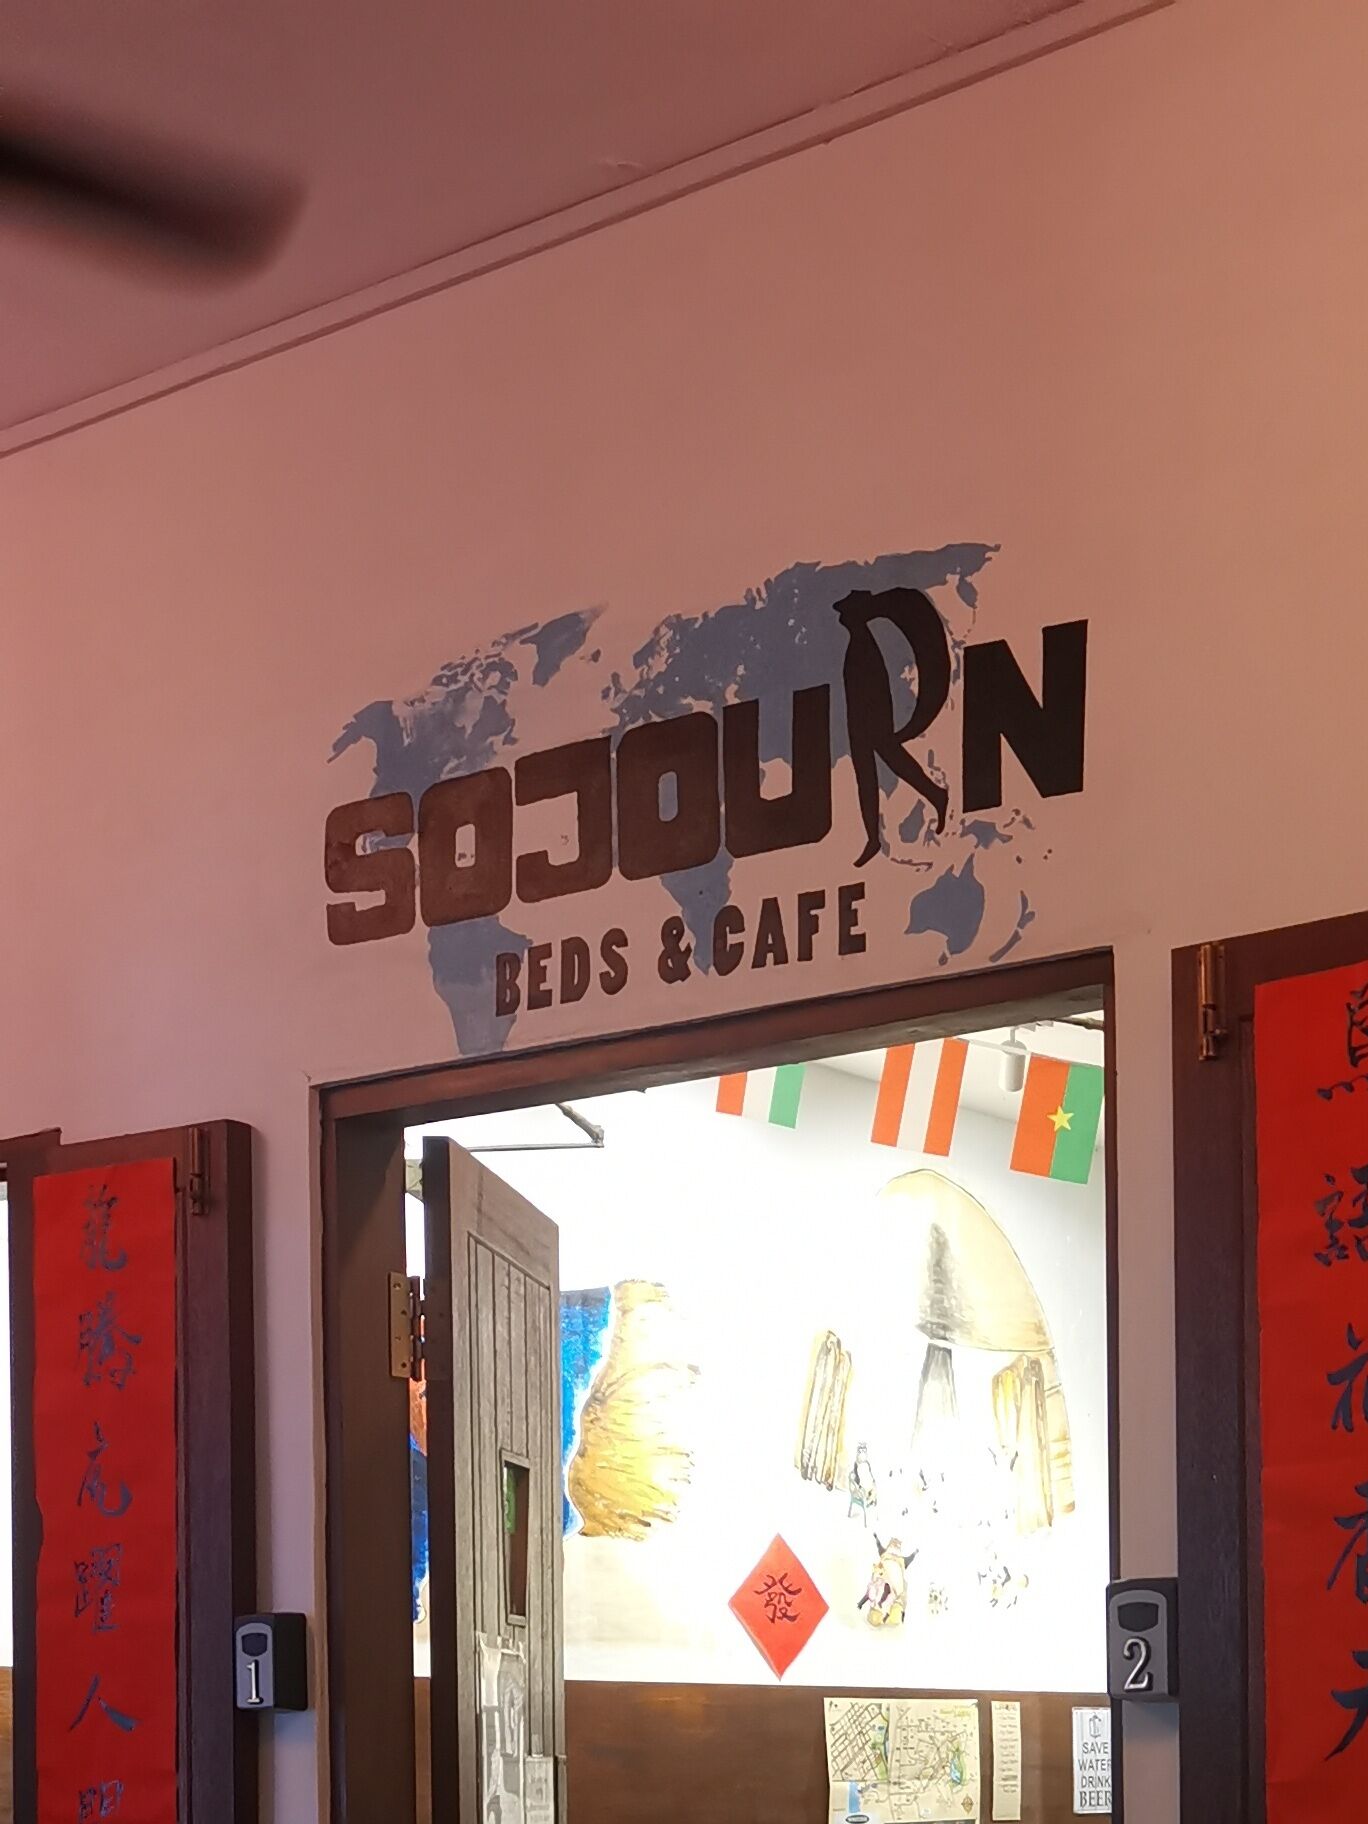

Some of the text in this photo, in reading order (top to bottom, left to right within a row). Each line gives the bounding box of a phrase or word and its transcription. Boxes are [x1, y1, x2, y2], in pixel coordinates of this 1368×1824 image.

[325, 588, 1089, 945] SOJOURN
[496, 881, 867, 1017] BEDS & CAFE
[246, 1659, 264, 1704] 1
[1124, 1637, 1153, 1691] 2
[1082, 1742, 1109, 1754] SAVE
[1079, 1791, 1112, 1808] BEER
[1081, 1776, 1111, 1788] DRINK
